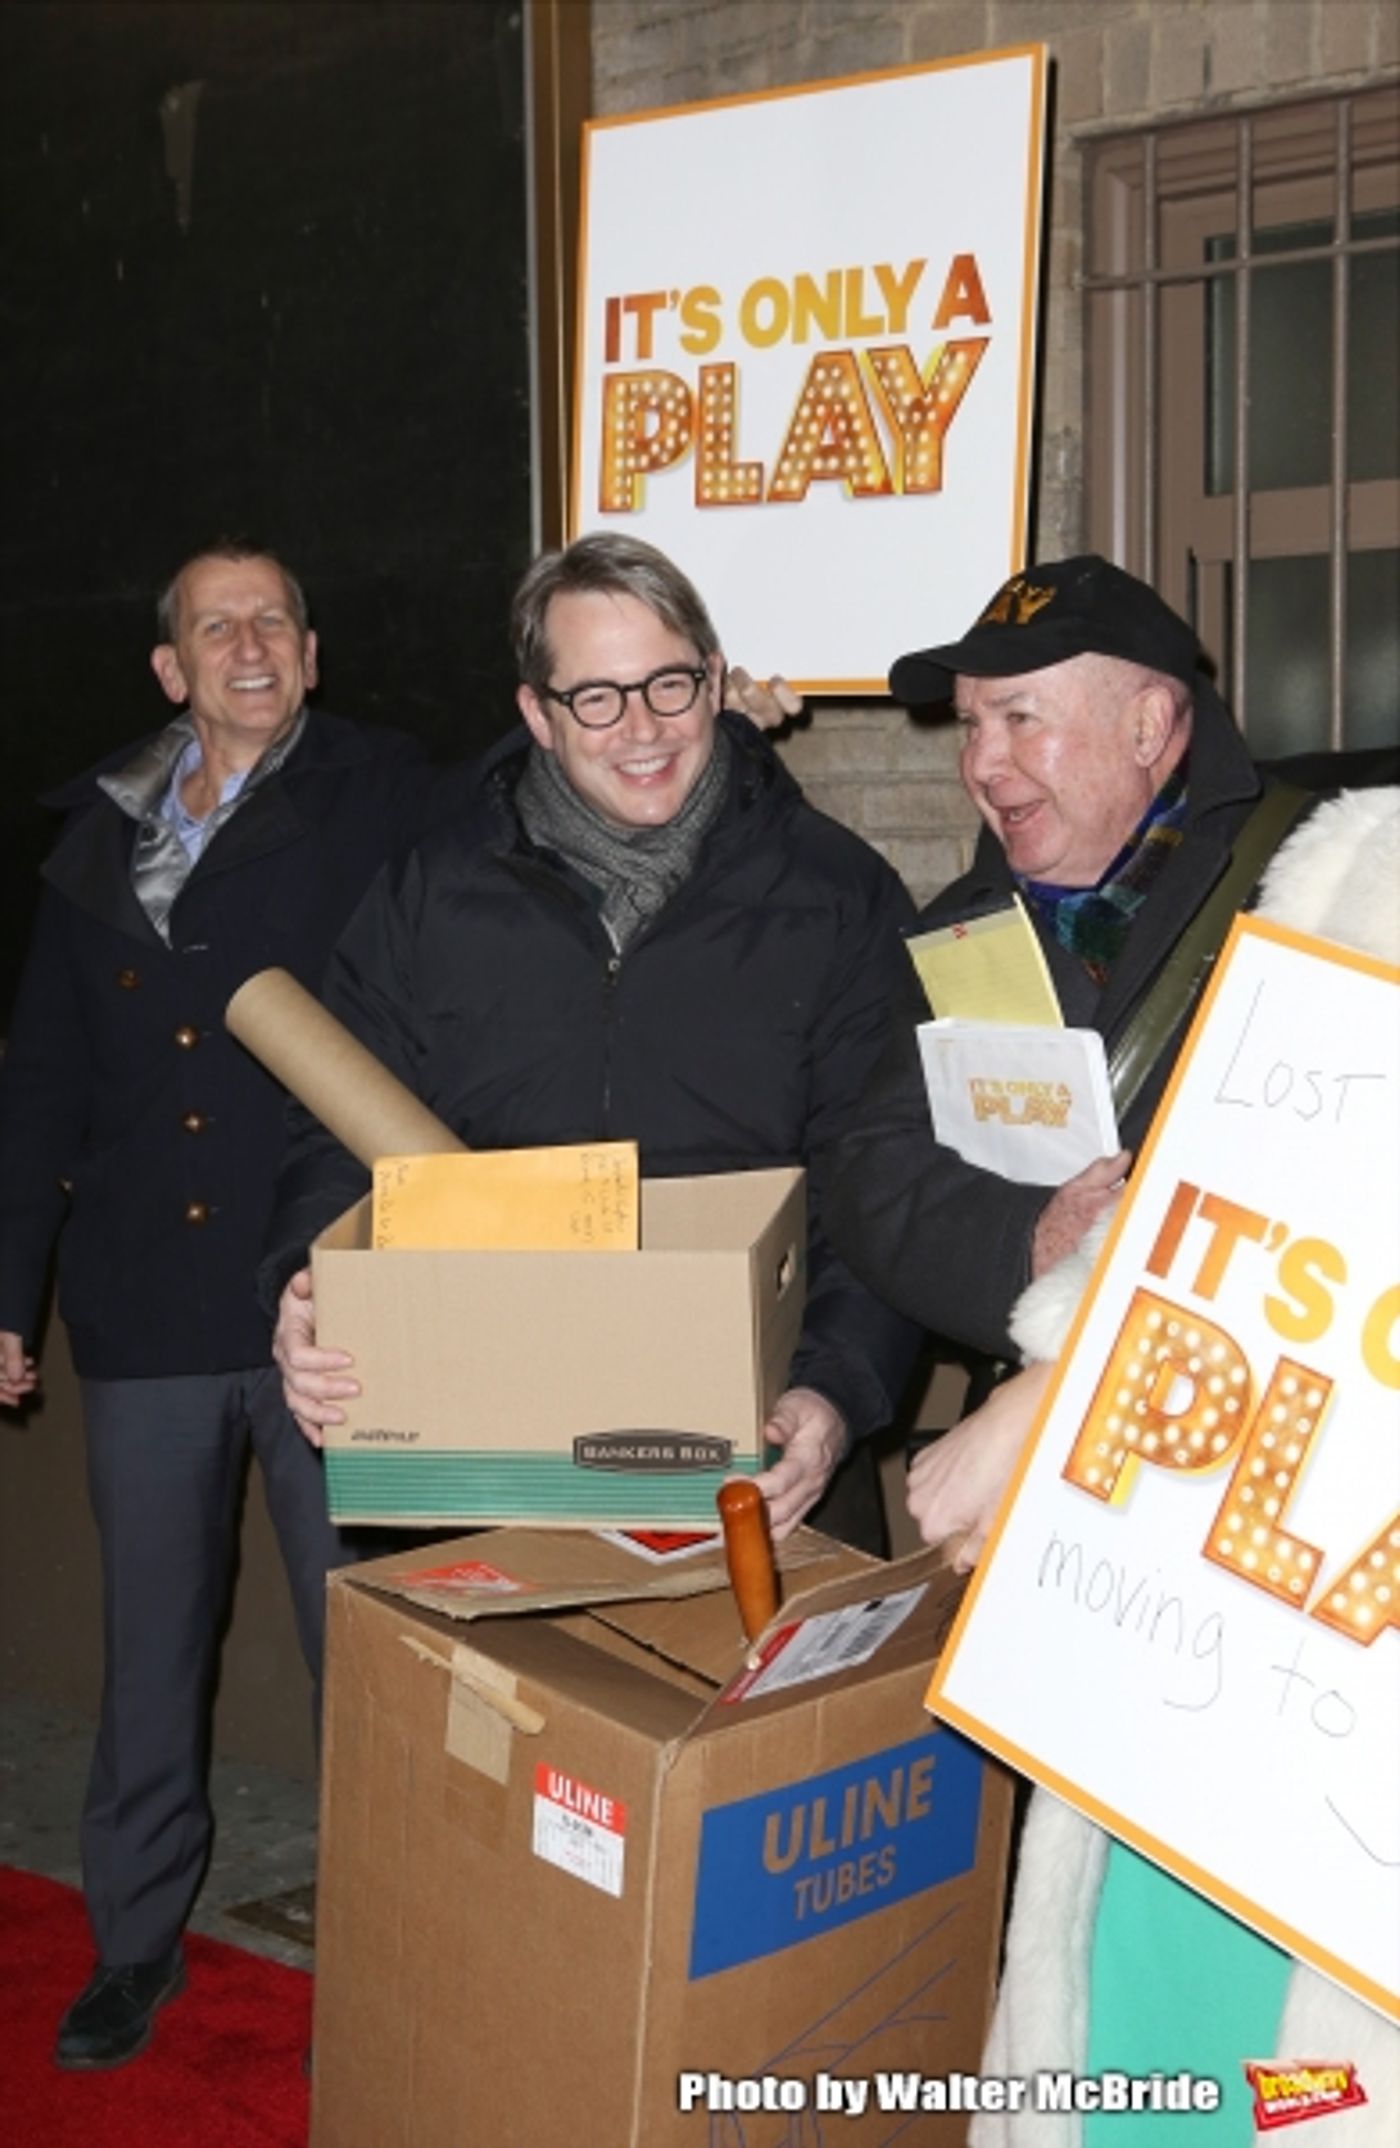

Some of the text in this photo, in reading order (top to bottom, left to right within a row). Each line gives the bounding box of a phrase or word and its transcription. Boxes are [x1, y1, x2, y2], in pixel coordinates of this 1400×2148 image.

[605, 253, 992, 363] IT'S ONLY A
[599, 336, 990, 514] PLAY
[973, 1095, 1071, 1128] PLAY
[1145, 1179, 1348, 1344] IT'S
[583, 1445, 721, 1461] BANKERS BOX
[1038, 1530, 1225, 1712] moving
[1271, 1636, 1357, 1739] to
[547, 1771, 615, 1827] ULINE
[762, 1755, 935, 1873] ULINE
[794, 1845, 896, 1920] TUBES
